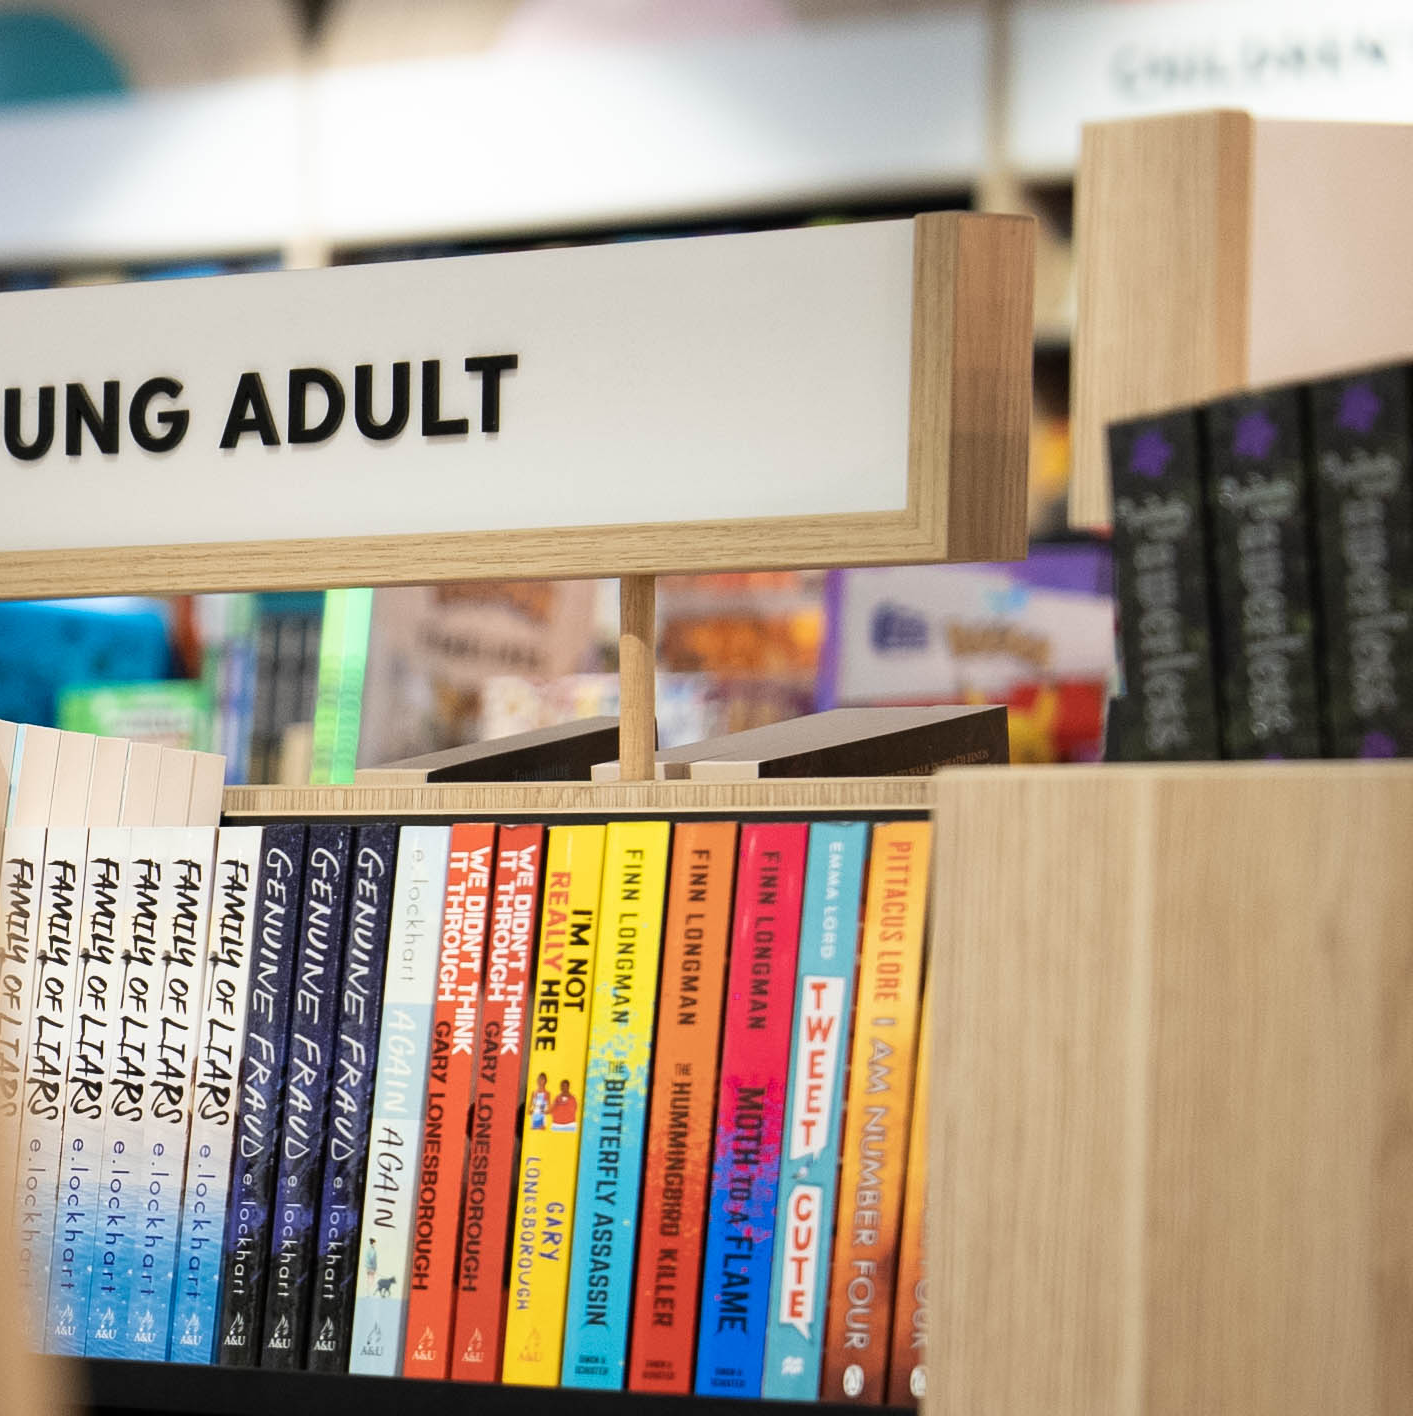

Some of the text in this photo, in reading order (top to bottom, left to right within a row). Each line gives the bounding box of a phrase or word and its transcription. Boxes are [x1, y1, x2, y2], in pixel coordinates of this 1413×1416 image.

[219, 354, 519, 449] ADULT
[438, 851, 469, 1001] IT THROUGH
[452, 846, 492, 1056] WE DIDN'T THINK
[487, 850, 518, 1001] IT THROUGH
[500, 845, 537, 1055] WE DIDN'T THINK
[535, 871, 571, 1051] REALLY HERE
[563, 909, 593, 1013] I'M NOT
[612, 849, 644, 1024] FINN LONGMAN
[677, 849, 710, 1026] FINN LONGMAN
[747, 852, 781, 1030] FINN LONGMAN
[820, 841, 844, 961] EMMA LORD
[874, 841, 913, 1002] PITTACUS LORE
[26, 860, 76, 1121] FAMILY OF LIARS
[70, 857, 119, 1119] FAMILY OF LIARS
[111, 858, 161, 1121] FAMILY OF LIARS
[151, 858, 202, 1123] FAMILY OF LIARS
[197, 859, 249, 1125] FAMILY OF LIARS
[240, 847, 293, 1159] GENUINE FRAUD
[285, 848, 340, 1160] GENUINE FRAUD
[331, 847, 385, 1161] GENUINE FRAUD
[381, 1008, 416, 1113] AGAIN
[802, 982, 834, 1146] TWEET
[373, 1127, 404, 1229] AGAIN
[412, 1021, 451, 1290] GARY LONESBOROUGH
[462, 1020, 500, 1292] GARY LONESBOROUGH
[595, 1079, 627, 1206] BUTTERFLY
[659, 1082, 692, 1237] HUMMINGBIRD
[729, 1176, 753, 1201] TO
[732, 1086, 766, 1166] MOTH
[843, 1017, 896, 1350] I AM NUMBER FOUR
[516, 1156, 541, 1311] LONESBOROUGH
[539, 1201, 565, 1262] GARY
[585, 1212, 615, 1327] ASSASSIN
[653, 1248, 678, 1328] KILLER
[716, 1235, 753, 1336] FLAME
[728, 1210, 748, 1225] A
[788, 1193, 813, 1319] CUTE
